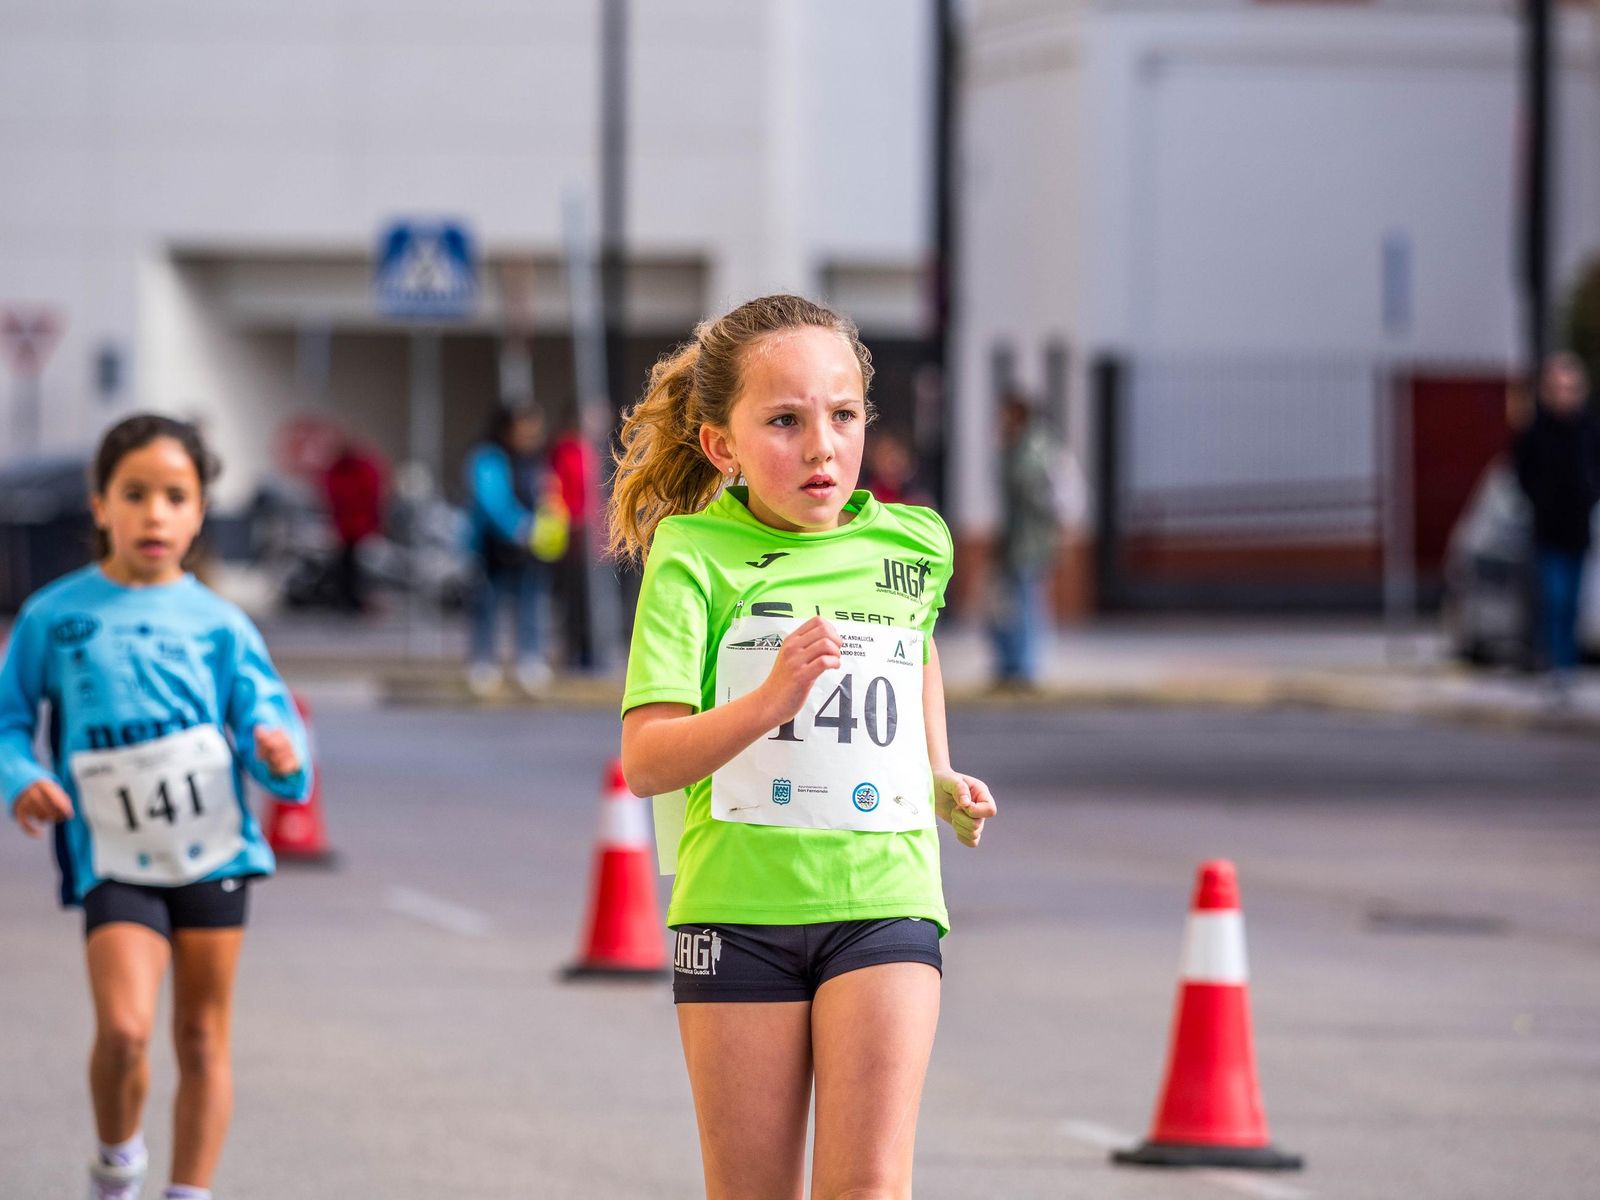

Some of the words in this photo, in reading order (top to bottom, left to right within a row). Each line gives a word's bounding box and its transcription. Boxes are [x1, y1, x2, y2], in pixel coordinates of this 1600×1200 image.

[875, 558, 919, 599] JAG
[834, 610, 895, 626] SEAT
[116, 772, 206, 832] 141
[674, 931, 711, 970] JAG
